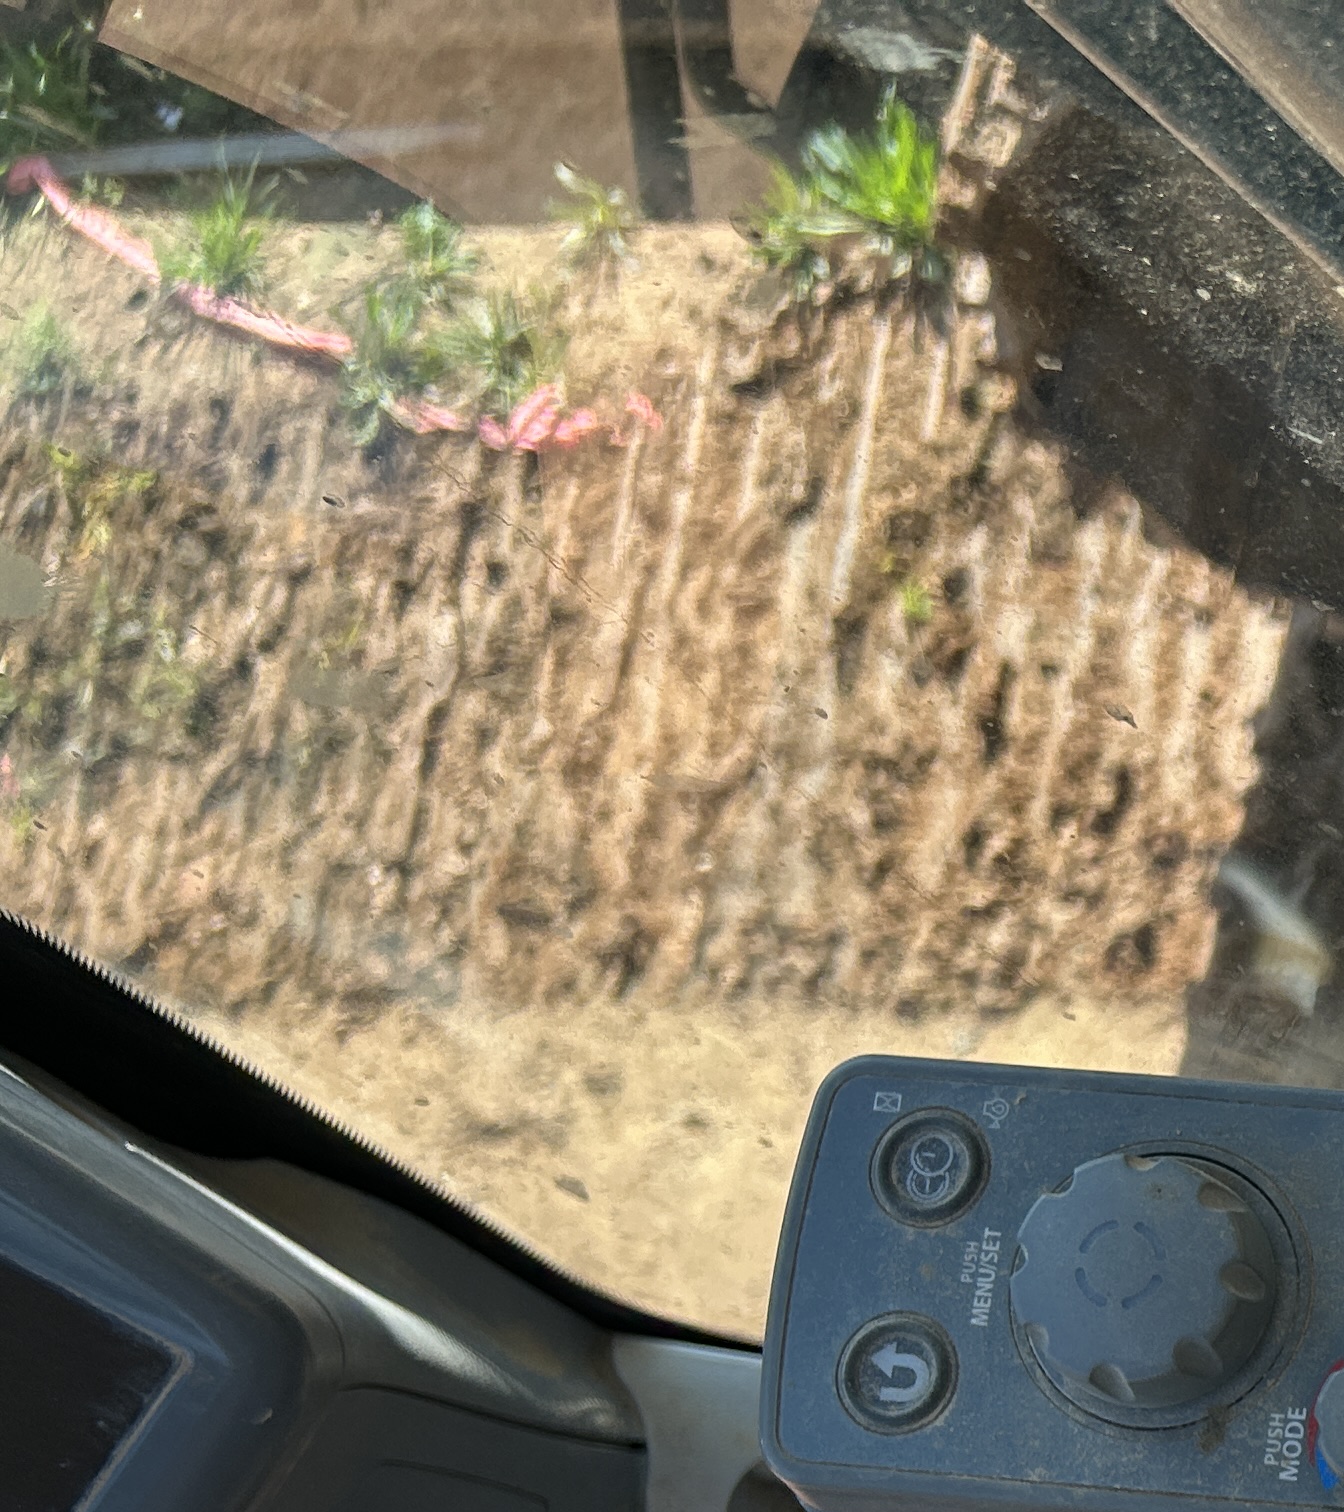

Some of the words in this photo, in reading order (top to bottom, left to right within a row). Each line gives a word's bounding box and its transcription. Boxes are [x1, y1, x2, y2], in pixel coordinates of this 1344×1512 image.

[961, 1240, 980, 1284] PUSH
[970, 1227, 1002, 1327] MENU/SET
[1263, 1413, 1285, 1466] PUSH
[1279, 1406, 1308, 1481] MODE
